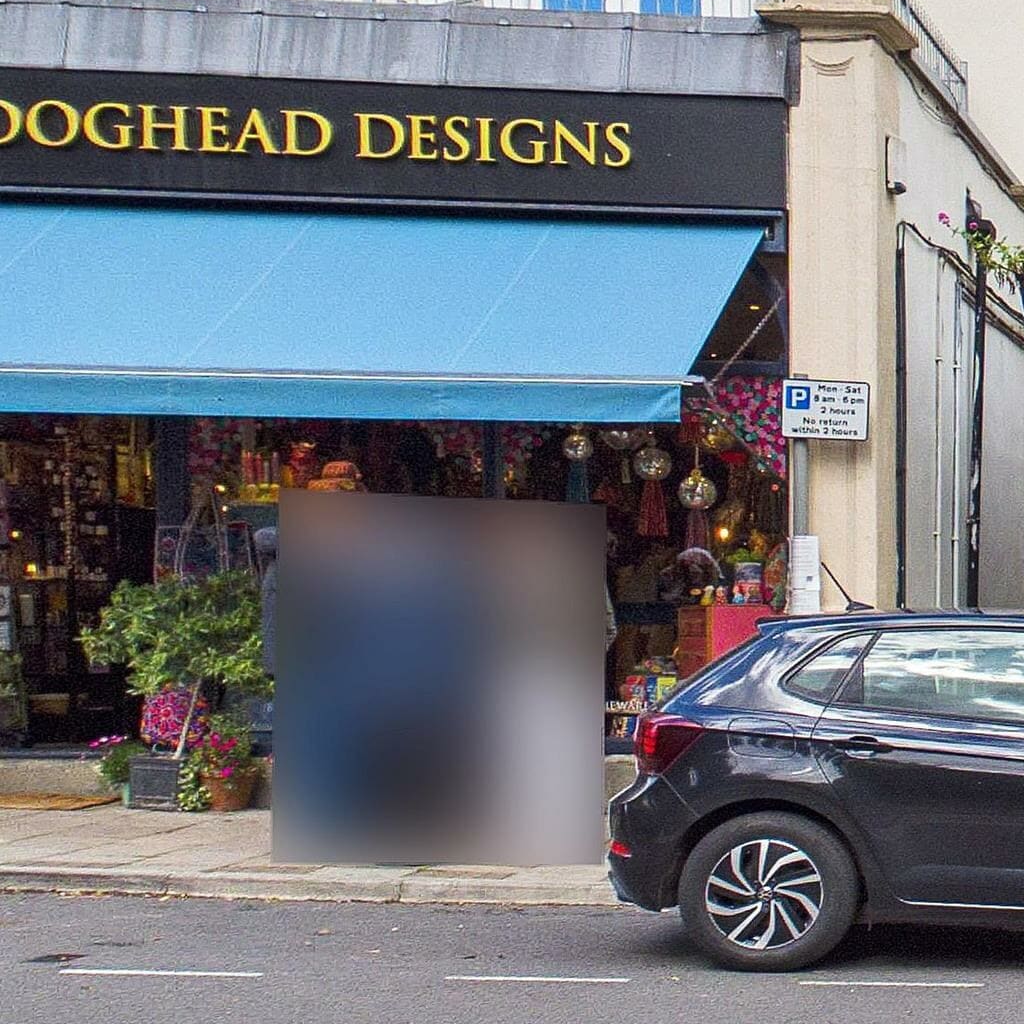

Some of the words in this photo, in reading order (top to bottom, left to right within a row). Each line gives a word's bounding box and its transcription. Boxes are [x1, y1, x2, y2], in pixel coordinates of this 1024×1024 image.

[354, 112, 633, 167] DESIGNS
[818, 384, 837, 393] Mon
[845, 386, 861, 394] Sat
[791, 388, 807, 407] P
[829, 407, 856, 415] hours
[803, 417, 816, 425] No
[819, 418, 848, 426] return
[792, 426, 820, 434] within
[823, 427, 830, 435] 2
[832, 427, 858, 436] hours
